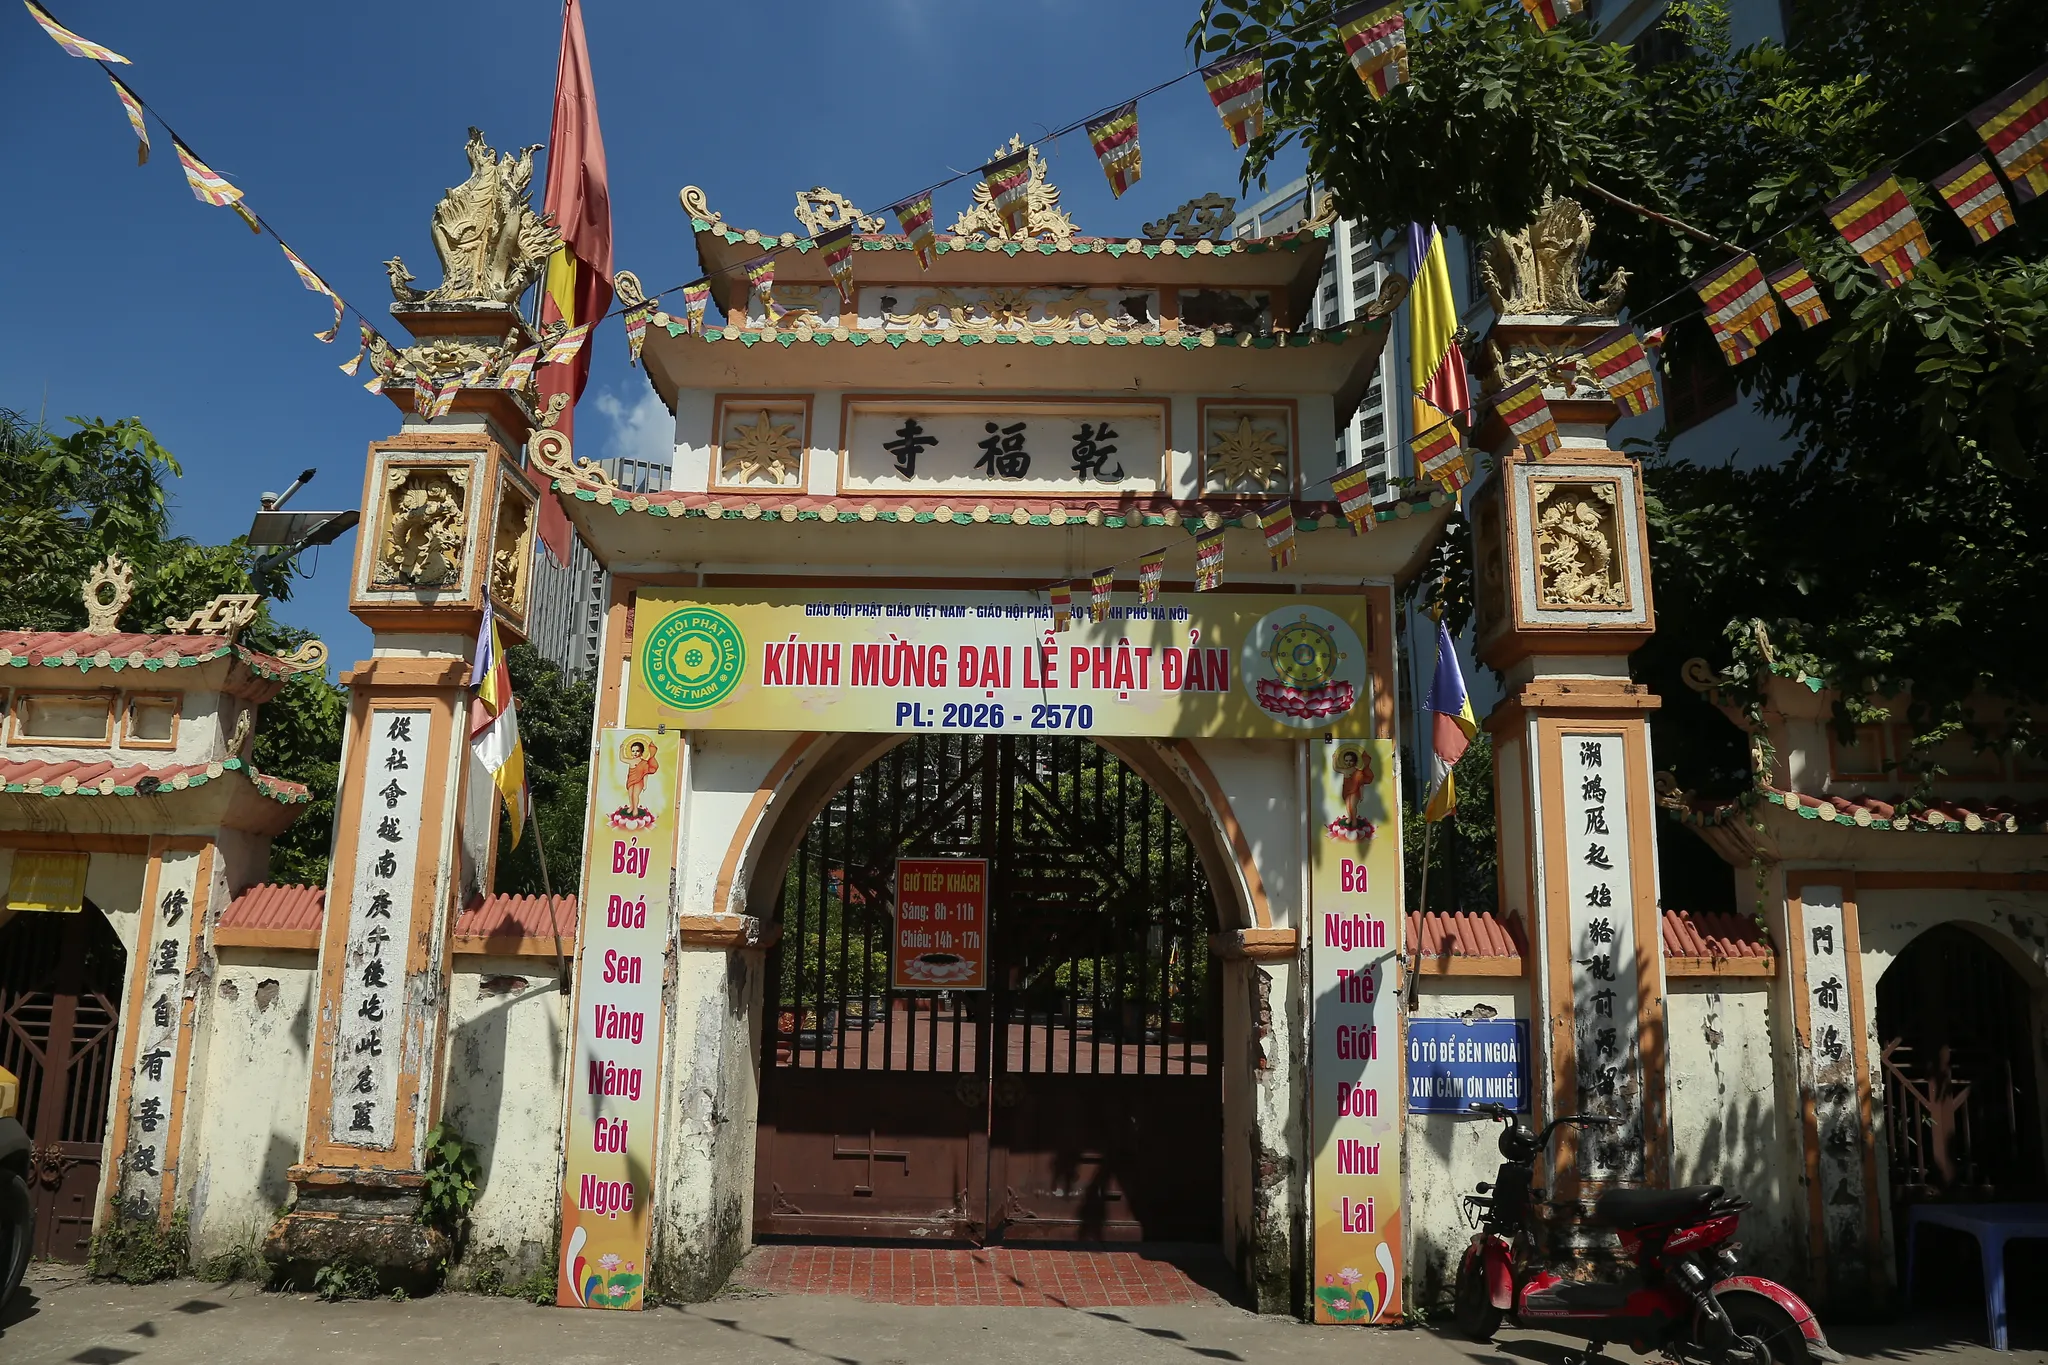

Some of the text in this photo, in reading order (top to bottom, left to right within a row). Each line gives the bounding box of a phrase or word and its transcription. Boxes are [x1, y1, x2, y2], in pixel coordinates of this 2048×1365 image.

[805, 601, 831, 617] GIÁO
[834, 601, 852, 620] HỘI
[855, 602, 883, 620] PHẬT
[886, 602, 911, 618] GIÁO
[915, 602, 938, 620] VIỆT
[940, 605, 966, 618] NAM
[976, 603, 1001, 618] GIÁO
[1005, 603, 1024, 621] HỘI
[1125, 603, 1148, 620] PHỐ
[1151, 604, 1166, 620] HÀ
[1168, 604, 1188, 623] NỘI
[652, 618, 737, 671] GIÁO HỘI PHẬT GIÁO
[763, 629, 1229, 699] KÍNH MỪNG ĐẠI LỄ PHẬT ĐẢN
[665, 681, 719, 699] VIỆT NAM
[896, 702, 933, 727] PL:
[942, 703, 1004, 728] 2026
[1031, 704, 1093, 729] 2570
[612, 837, 650, 878] Bảy
[903, 868, 980, 893] GIỜ TIẾP KHÁCH
[1341, 859, 1367, 893] Ba
[607, 894, 646, 929] Đoá
[902, 902, 929, 921] Sáng:
[934, 903, 947, 920] 8h
[957, 903, 974, 921] 11h
[901, 926, 932, 948] Chiều:
[935, 931, 952, 948] 14h
[962, 932, 979, 948] 17h
[1325, 912, 1385, 952] Nghìn
[603, 949, 642, 984] Sen
[1337, 963, 1375, 1004] Thế
[594, 1004, 644, 1044] Vàng
[1336, 1024, 1377, 1060] Giới
[1411, 1038, 1420, 1062] Ô
[1422, 1038, 1437, 1062] TÔ
[1440, 1034, 1455, 1062] ĐỂ
[1458, 1038, 1481, 1062] BÊN
[588, 1060, 642, 1101] Nâng
[1412, 1071, 1521, 1098] XIN CẢM ƠN NHIỀU
[1337, 1081, 1378, 1117] Đón
[594, 1117, 628, 1153] Gót
[1337, 1139, 1380, 1175] Như
[579, 1174, 634, 1219] Ngọc
[1342, 1196, 1375, 1233] Lai
